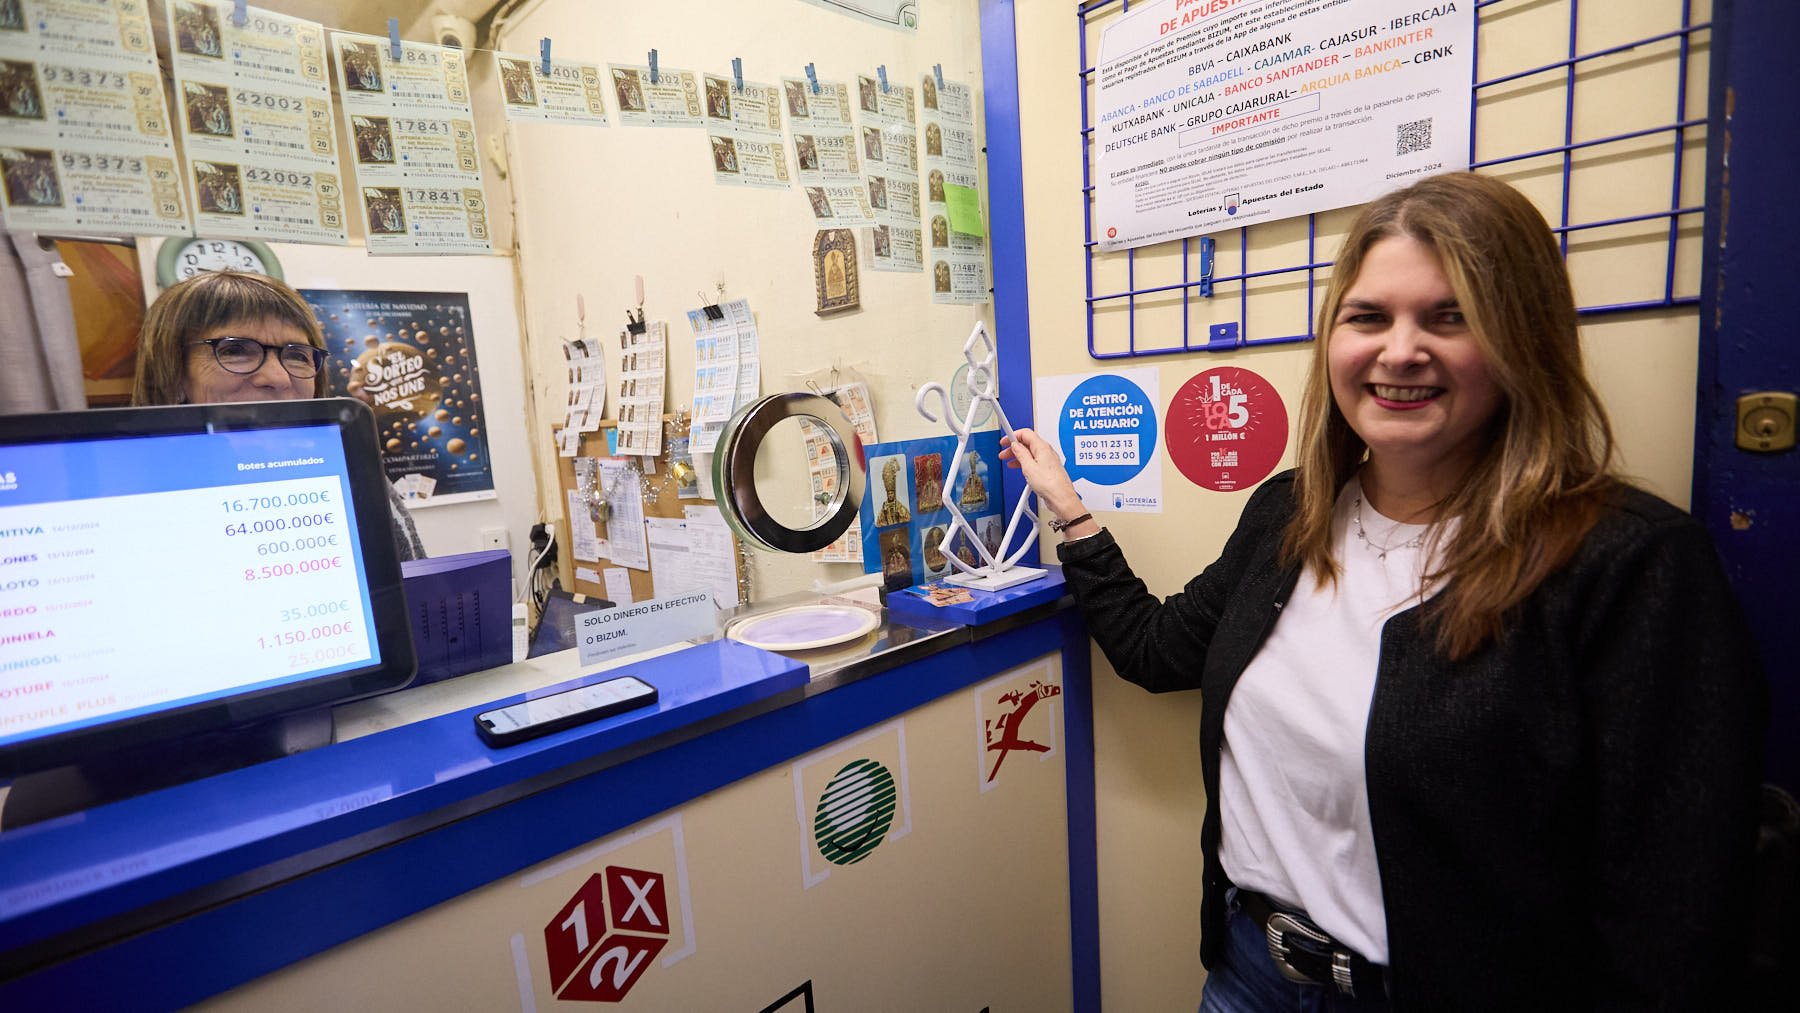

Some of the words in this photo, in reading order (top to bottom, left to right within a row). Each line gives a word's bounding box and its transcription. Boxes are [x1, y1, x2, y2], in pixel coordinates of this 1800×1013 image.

[226, 13, 293, 34] 4002
[1150, 45, 1165, 54] Pago
[1176, 29, 1201, 43] Premios
[1202, 23, 1219, 34] cuyo
[1220, 11, 1248, 26] importe
[1250, 6, 1263, 15] sea
[1160, 18, 1178, 35] DE
[1124, 65, 1138, 73] Pago
[1148, 50, 1174, 64] Apuestas
[1176, 37, 1206, 53] mediante
[1207, 26, 1232, 41] BIZUM,
[1234, 22, 1243, 30] en
[1245, 16, 1261, 26] este
[1125, 65, 1157, 81] registrados
[1166, 52, 1187, 65] BIZUM
[1194, 42, 1214, 54] través
[1215, 38, 1225, 46] de
[1225, 35, 1232, 43] la
[1233, 29, 1247, 41] App
[1248, 25, 1258, 34] de
[1259, 17, 1286, 30] alguna
[1299, 6, 1321, 17] estas
[384, 48, 438, 63] 1841
[1101, 104, 1136, 123] ABANCA
[1143, 90, 1176, 109] BANCO
[1178, 85, 1191, 97] DE
[1193, 66, 1244, 91] SABADELL
[1319, 25, 1377, 50] CAJASUR
[1390, 2, 1457, 30] IBERCAJA
[1188, 59, 1215, 76] BBVA
[1226, 33, 1292, 62] CAIXABANK
[44, 65, 125, 90] 93373
[535, 65, 580, 79] 9400
[642, 73, 680, 85] 4002
[1112, 110, 1165, 133] KUTXABANK
[1173, 92, 1215, 113] UNICAJA
[1224, 77, 1262, 97] BANCO
[1266, 53, 1340, 84] SANTANDER
[1354, 28, 1433, 58] BANKINTER
[236, 92, 303, 112] 42002
[1105, 132, 1149, 153] DEUTSCHE
[1150, 123, 1176, 139] BANK
[1187, 109, 1223, 127] GRUPO
[1300, 72, 1351, 94] ARQUIA
[1414, 45, 1454, 64] CBNK
[1211, 108, 1280, 135] IMPORTANTE
[1237, 129, 1271, 144] transacción
[1272, 126, 1280, 134] de
[1281, 121, 1299, 131] dicho
[1300, 115, 1323, 129] premio
[1331, 107, 1352, 119] través
[1353, 104, 1363, 114] de
[1364, 101, 1371, 111] la
[1372, 95, 1403, 112] pasarela
[1405, 92, 1415, 101] de
[1416, 86, 1442, 102] pagos.
[396, 120, 449, 134] 17841
[316, 139, 327, 148] 20
[1187, 156, 1207, 168] cobrar
[1208, 149, 1230, 161] ningún
[1231, 146, 1244, 156] tipo
[1255, 135, 1286, 149] comisión
[1287, 133, 1298, 142] por
[1299, 123, 1324, 138] realizar
[1325, 122, 1332, 131] la
[62, 153, 143, 174] 93373
[1386, 167, 1421, 180] Diciembre
[1423, 162, 1442, 173] 2024
[246, 169, 312, 187] 42002
[407, 190, 460, 202] 17841
[1188, 204, 1217, 217] Loterías
[1217, 204, 1223, 212] y
[1242, 193, 1278, 206] Apuestas
[1280, 189, 1293, 197] del
[1295, 183, 1324, 194] Estado
[163, 203, 175, 214] 20
[326, 214, 336, 222] 20
[211, 241, 226, 254] 12
[233, 245, 239, 257] 1
[243, 255, 253, 268] 2
[952, 262, 977, 272] 71487
[392, 303, 428, 311] NAVIDAD
[388, 351, 405, 364] EL
[374, 387, 398, 406] NOS
[399, 376, 425, 397] UNE
[1209, 375, 1221, 402] 1
[1221, 388, 1243, 396] CADA
[1082, 393, 1128, 406] CENTRO
[1069, 408, 1084, 418] DE
[1086, 403, 1143, 418] ATENCIÓN
[1228, 394, 1249, 428] 5
[1073, 420, 1088, 430] AL
[1089, 417, 1140, 429] USUARIO
[1080, 440, 1099, 448] 900
[1101, 440, 1108, 448] 11
[1110, 440, 1121, 448] 23
[1124, 440, 1133, 448] 13
[1205, 434, 1209, 442] 1
[1211, 431, 1238, 442] MILLÓN
[237, 460, 266, 471] Botes
[267, 456, 324, 470] acumulados
[1079, 452, 1093, 460] 915
[1095, 452, 1107, 460] 96
[1109, 451, 1120, 460] 23
[1122, 451, 1135, 459] 00
[221, 490, 331, 513] 16.700.000€
[1126, 496, 1157, 504] LOTERÍAS
[225, 512, 335, 537] 64.000.000€
[257, 534, 339, 556] 600.000€
[244, 556, 342, 581] 8.500.000€
[279, 599, 350, 623] 35.000€
[584, 614, 611, 627] SOLO
[613, 606, 649, 621] DINERO
[651, 603, 663, 612] EN
[665, 593, 707, 609] EFECTIVO
[257, 621, 353, 650] 1.150.000€
[586, 636, 594, 645] O
[596, 629, 628, 643] BIZUM.
[287, 643, 358, 669] 25.000€
[620, 875, 662, 926] X
[561, 900, 589, 955] 1
[589, 946, 649, 991] 2
